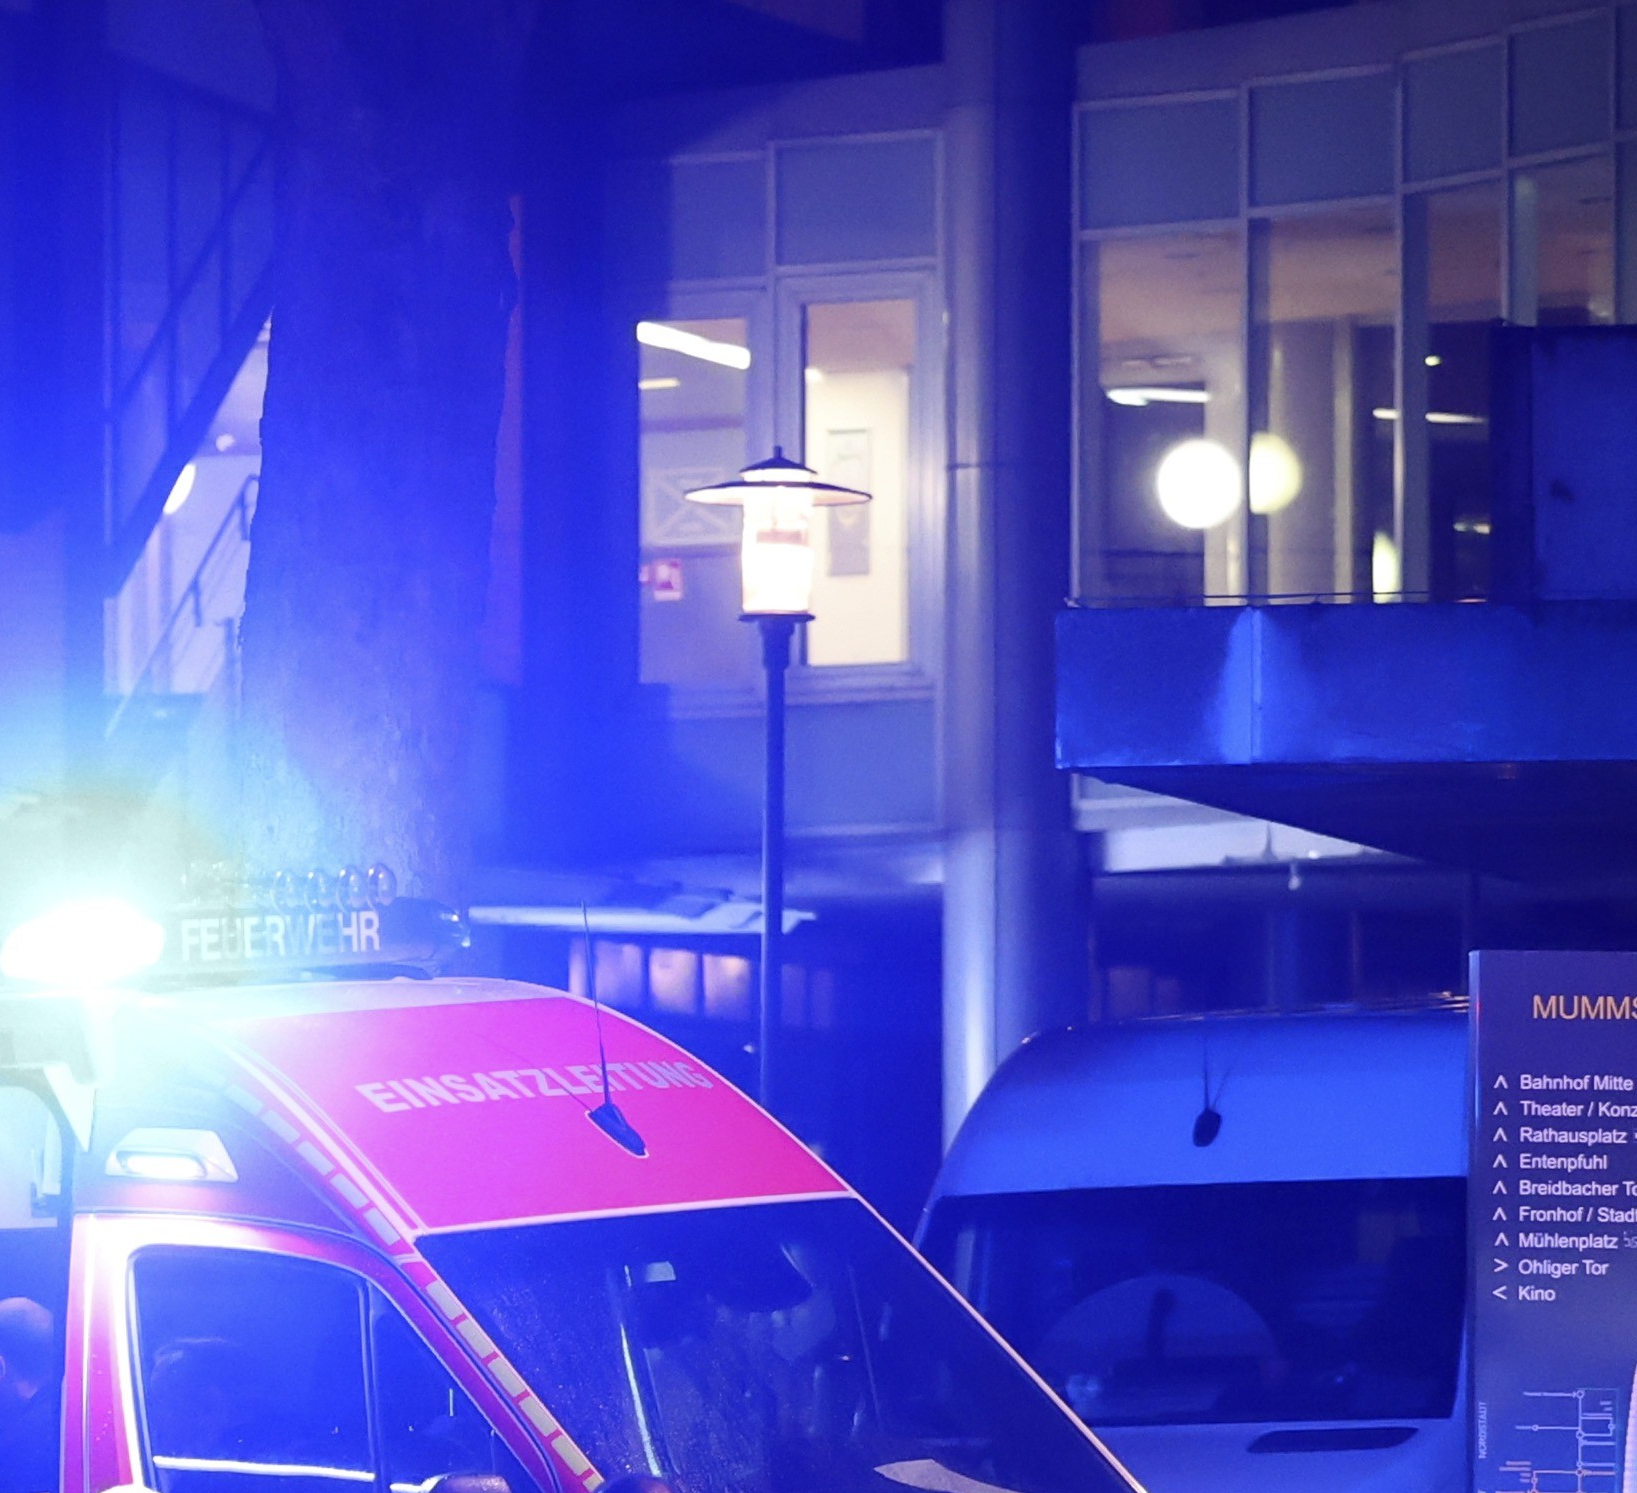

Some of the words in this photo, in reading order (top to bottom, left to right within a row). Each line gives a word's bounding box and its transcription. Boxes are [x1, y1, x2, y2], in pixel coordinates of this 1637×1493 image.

[180, 909, 380, 962] FEUERWEHR
[1532, 994, 1637, 1020] MUMM
[354, 1060, 714, 1114] EINSATZLEITUNG
[1520, 1073, 1590, 1090] Bahnhof
[1593, 1075, 1634, 1091] Mitte
[1519, 1100, 1584, 1117] Theater
[1519, 1126, 1627, 1146] Rathausplatz
[1519, 1153, 1608, 1173] Entenpfuhl
[1518, 1179, 1619, 1197] Breidbacher
[1518, 1205, 1584, 1222] Fronhof
[1597, 1206, 1637, 1224] Stad
[1518, 1232, 1618, 1252] Mühlenplatz
[1518, 1258, 1579, 1279] Ohliger
[1581, 1259, 1610, 1276] Tor
[1518, 1285, 1556, 1302] Kino
